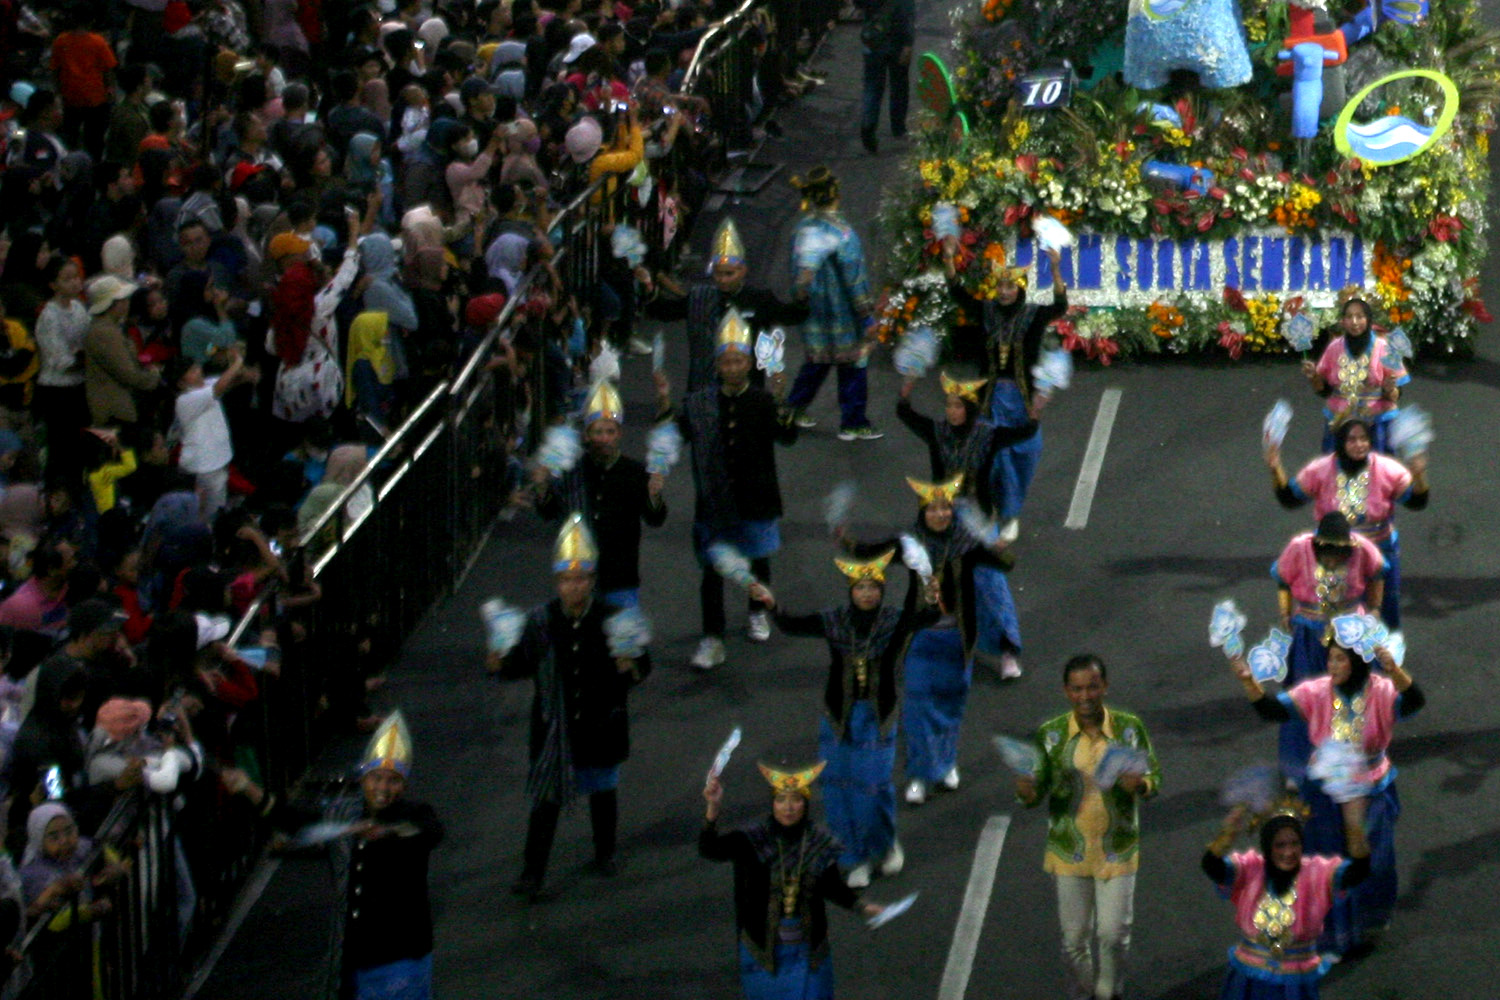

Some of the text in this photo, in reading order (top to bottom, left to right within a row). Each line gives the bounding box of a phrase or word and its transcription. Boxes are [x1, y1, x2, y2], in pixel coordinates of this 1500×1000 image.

[1022, 81, 1062, 106] 10
[1115, 235, 1212, 292] SURYA
[1223, 235, 1365, 291] SEMBADA
